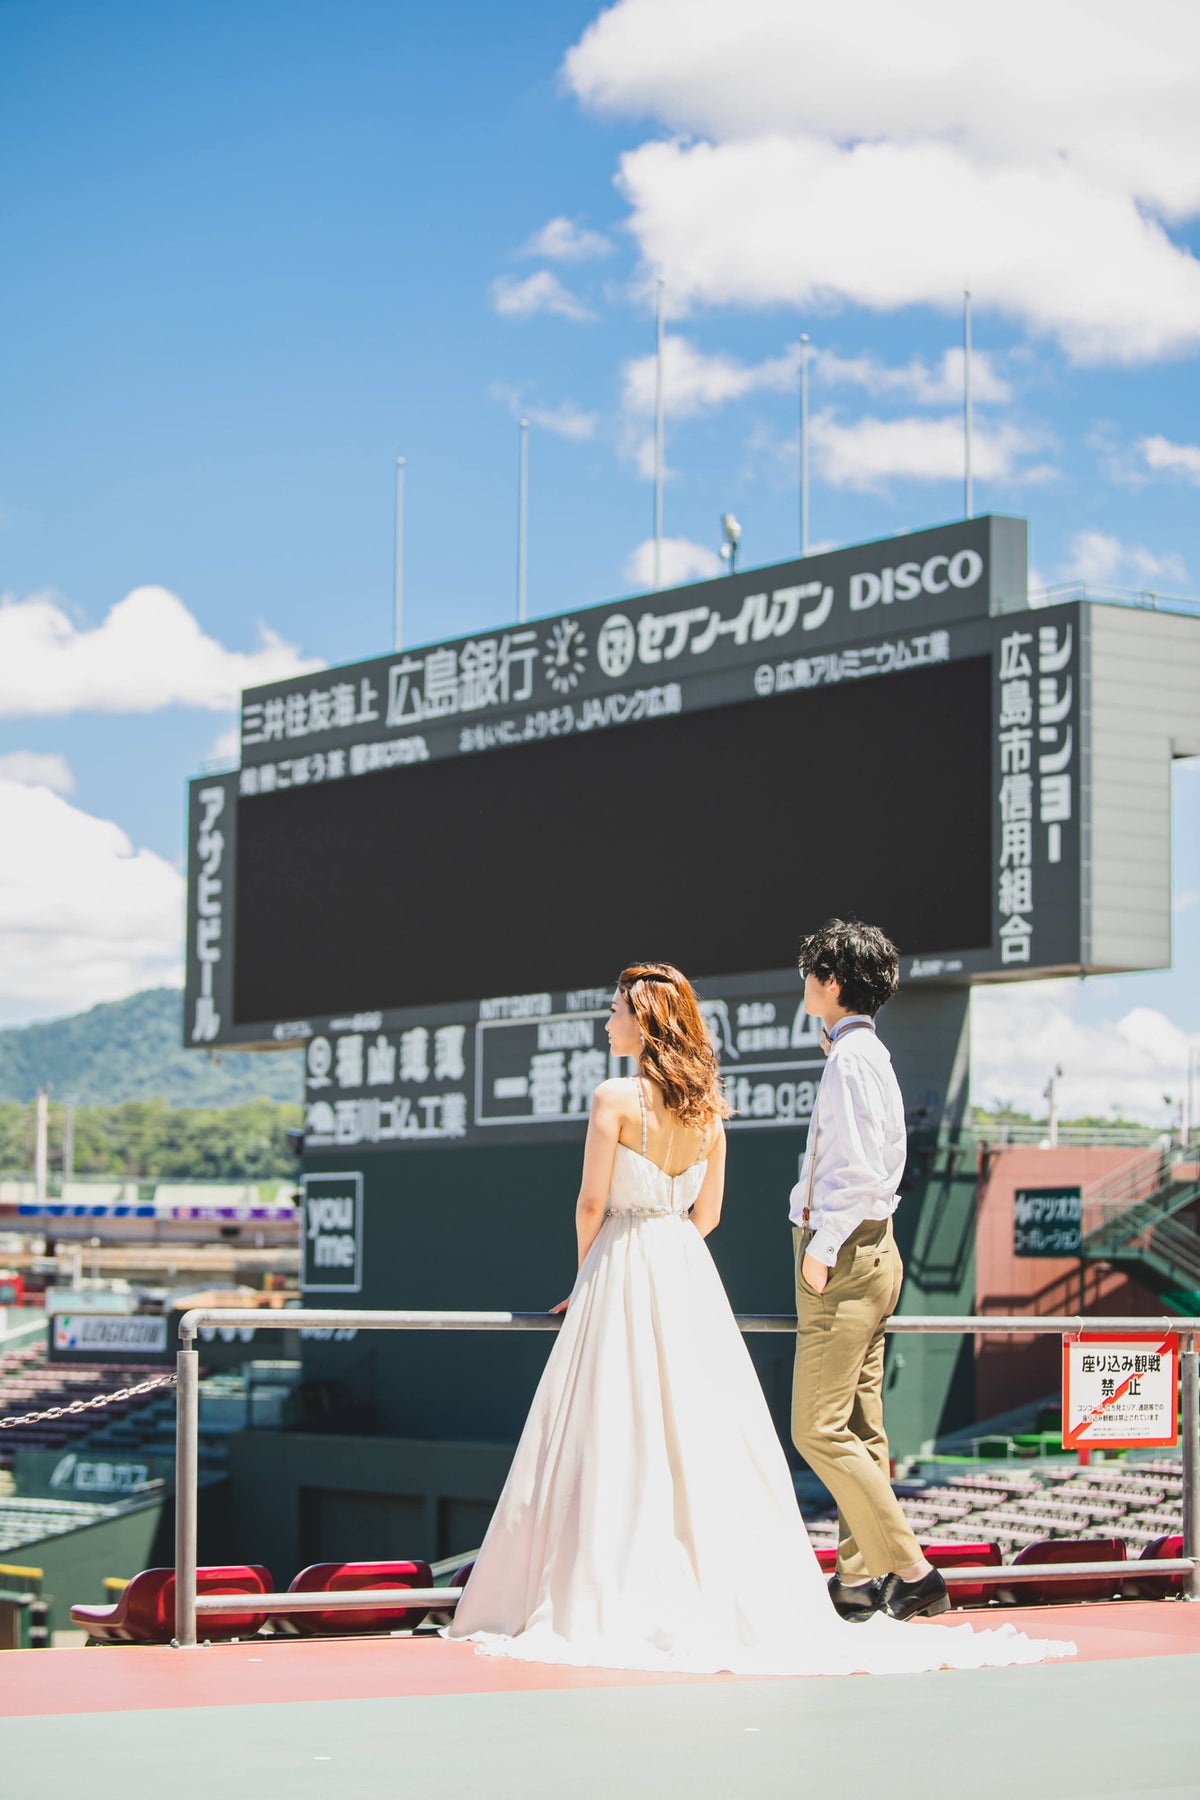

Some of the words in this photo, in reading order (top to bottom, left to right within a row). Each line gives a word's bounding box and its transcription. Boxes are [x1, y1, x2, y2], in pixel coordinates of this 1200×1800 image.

[850, 549, 983, 612] DISCO
[386, 631, 538, 728] 広島銀行
[775, 629, 951, 692] 広島アルミニウム工業
[241, 677, 380, 746] 三井住友海上
[1038, 622, 1074, 864] シシンヨー
[998, 630, 1034, 964] 広島市信用組合
[191, 785, 226, 1042] アサヒビール
[334, 1092, 468, 1146] 西川ゴム工業
[306, 1196, 354, 1238] you
[313, 1236, 357, 1268] me
[1081, 1354, 1161, 1373] 座り込み観戦
